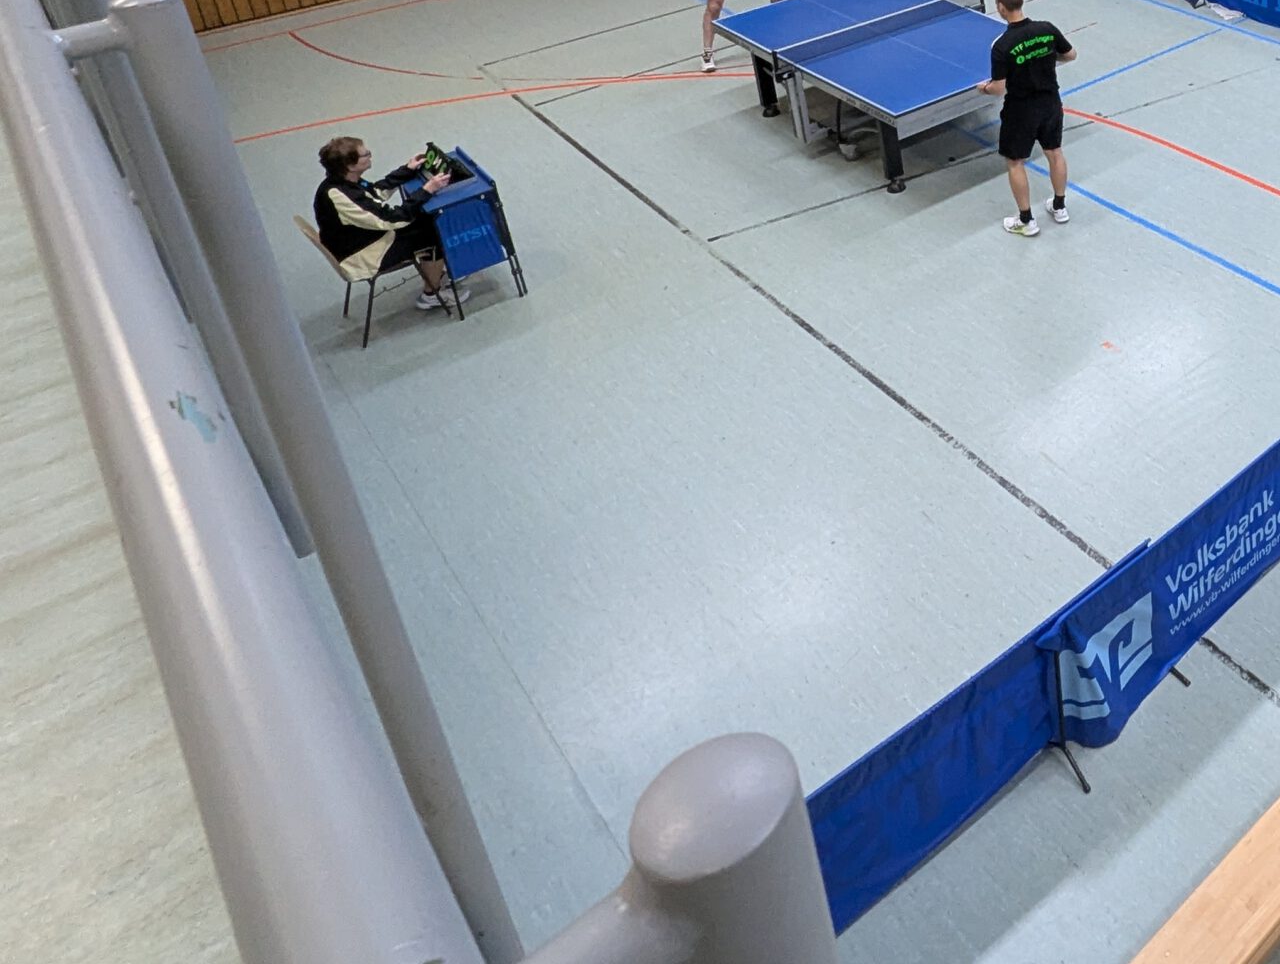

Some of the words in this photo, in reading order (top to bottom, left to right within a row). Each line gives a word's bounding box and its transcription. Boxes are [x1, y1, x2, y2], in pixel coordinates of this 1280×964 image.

[1010, 43, 1024, 55] TTF
[460, 224, 491, 243] TSP
[1165, 490, 1275, 594] Volksbank
